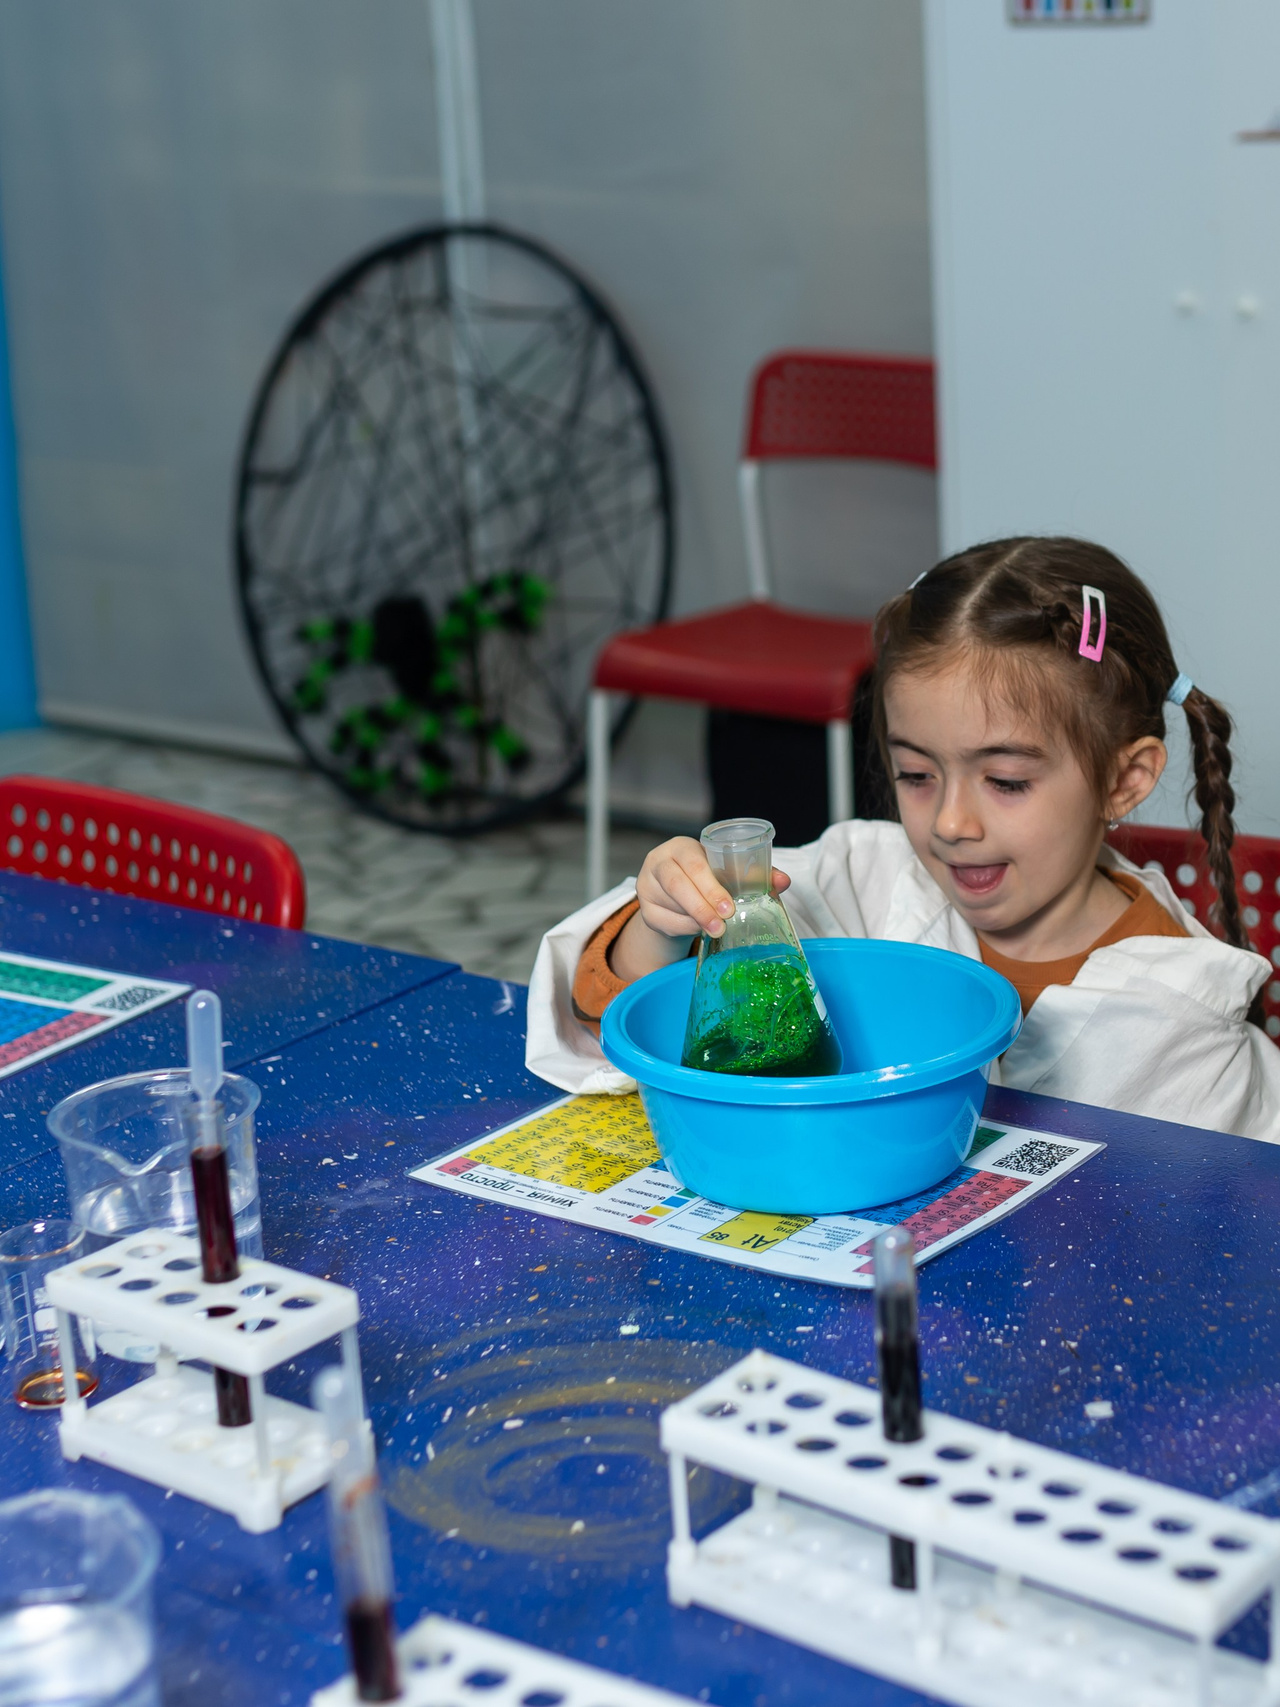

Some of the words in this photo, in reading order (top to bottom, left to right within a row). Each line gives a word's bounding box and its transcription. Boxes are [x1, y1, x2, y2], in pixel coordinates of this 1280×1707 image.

[459, 1172, 515, 1191] просто
[526, 1191, 578, 1207] ХИМИЯ
[706, 1231, 731, 1241] 85
[739, 1233, 779, 1250] At
